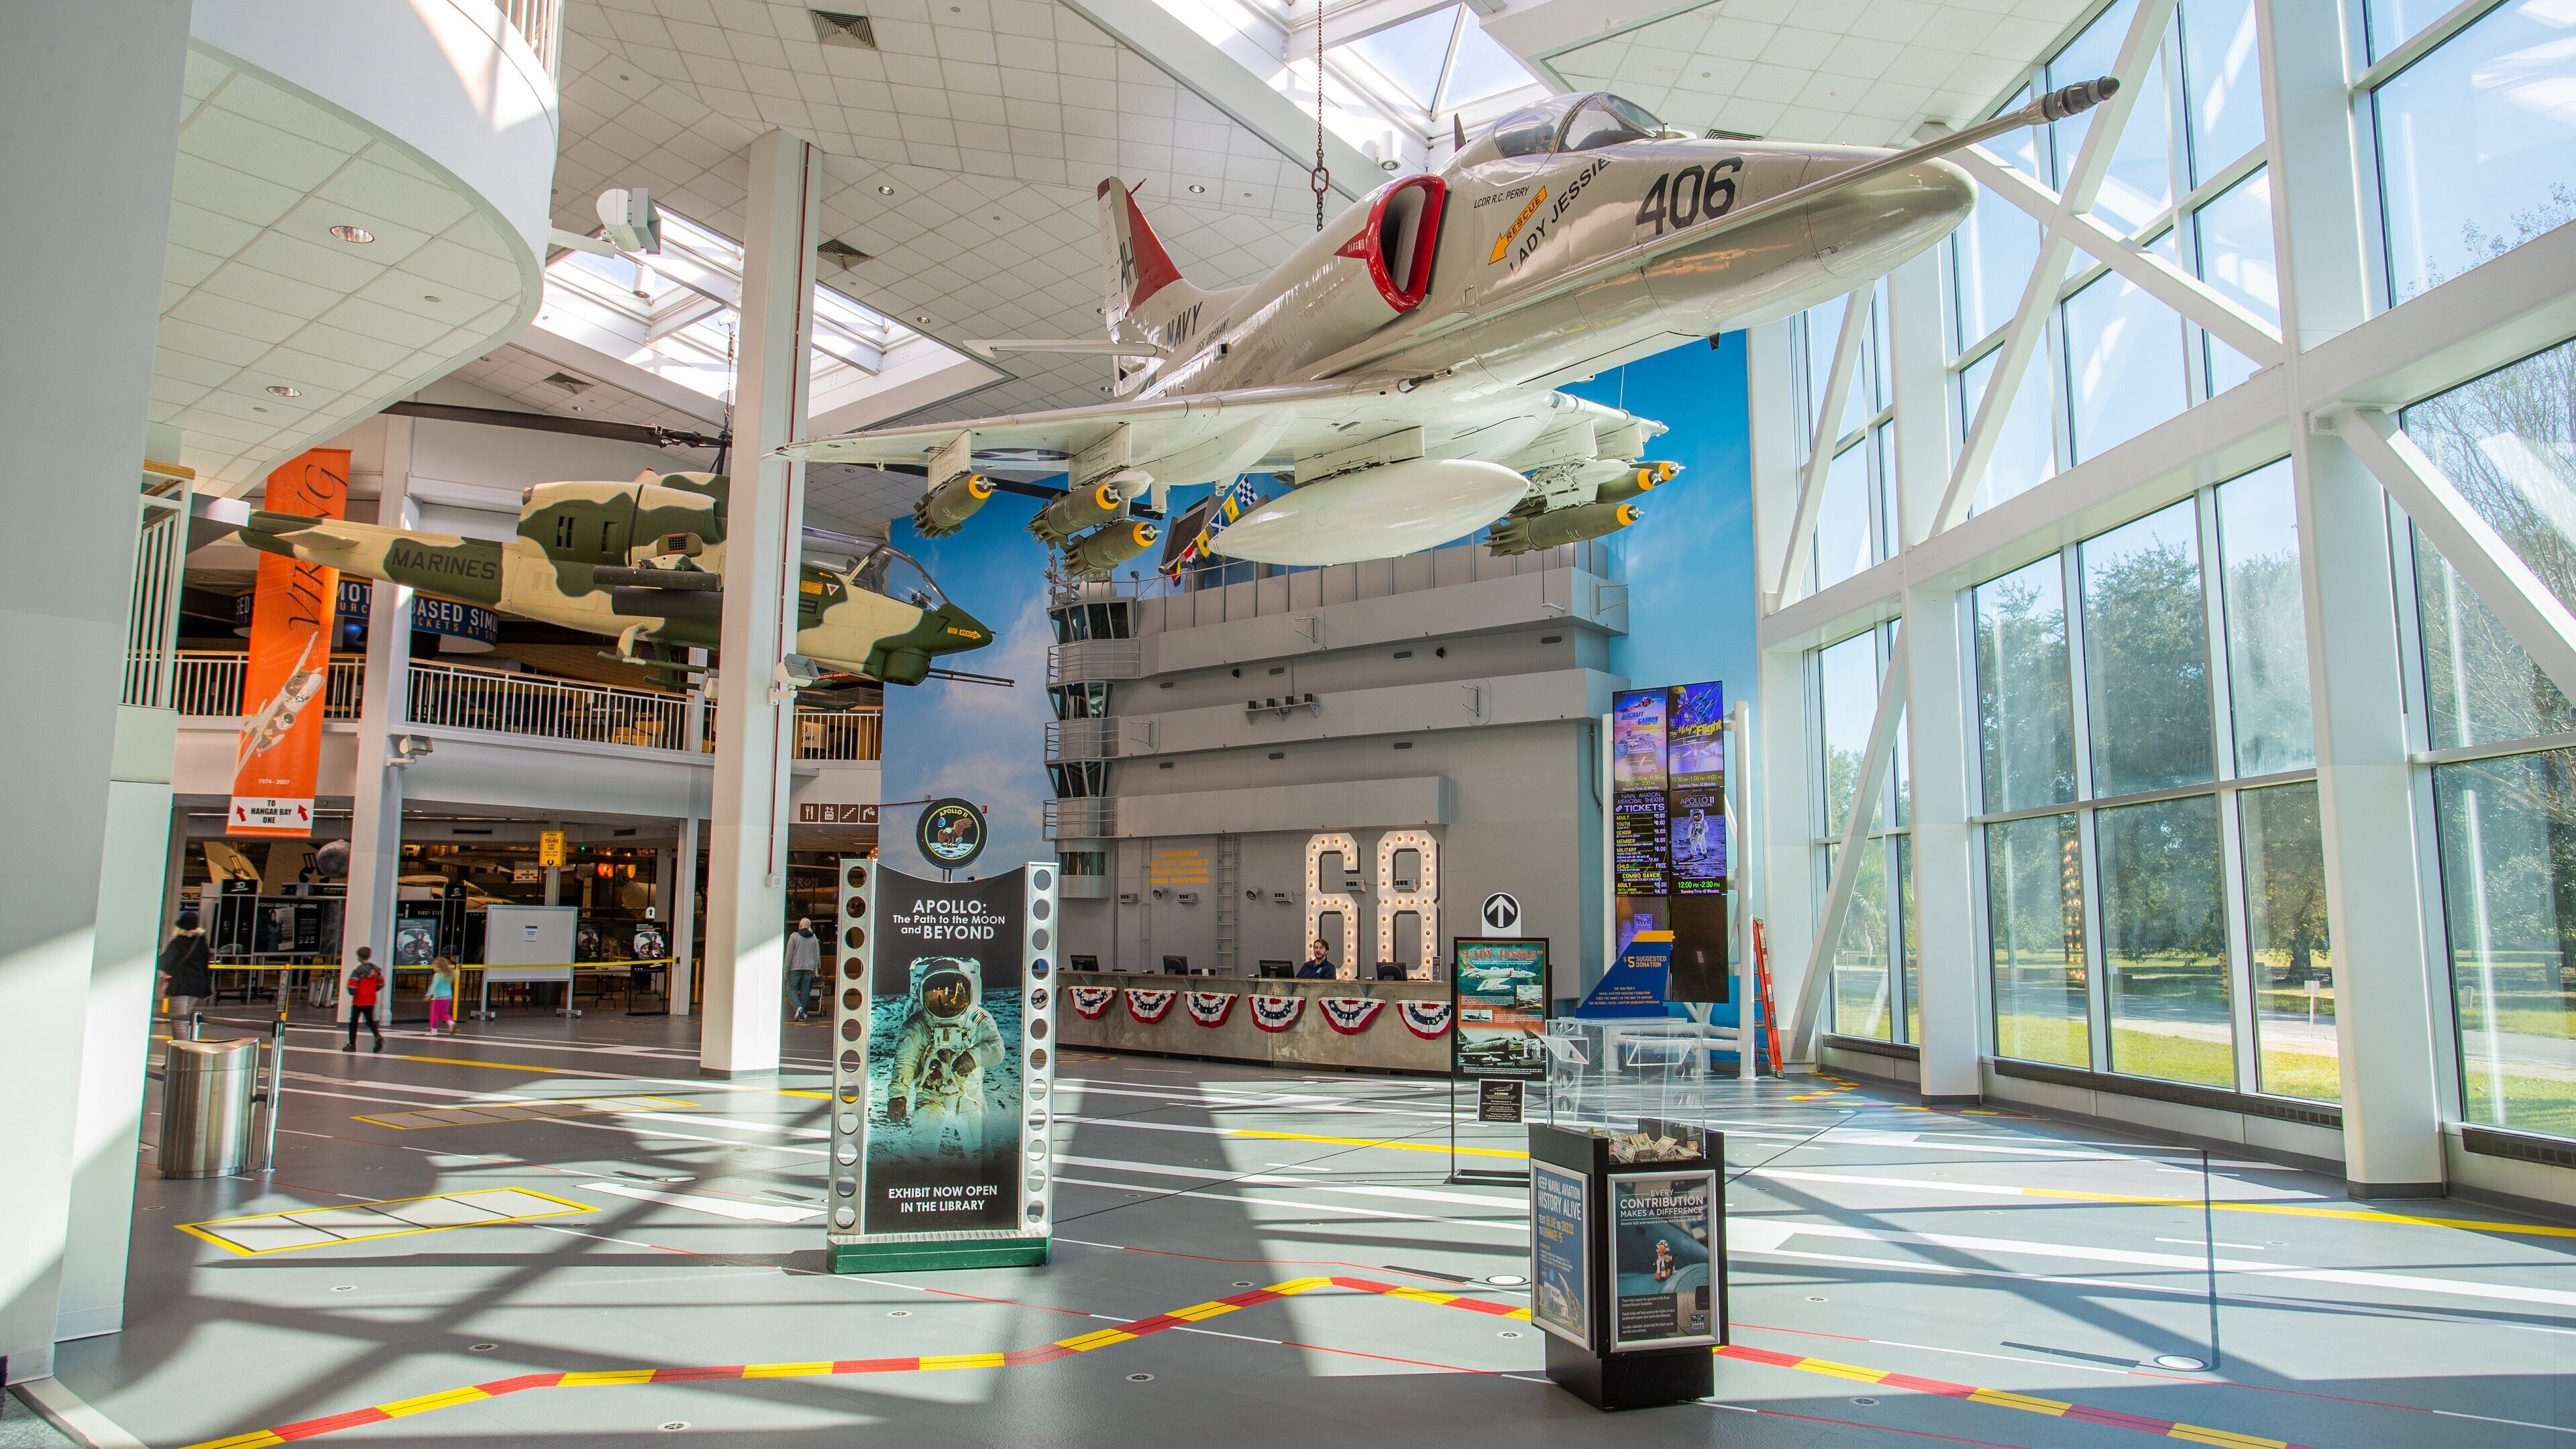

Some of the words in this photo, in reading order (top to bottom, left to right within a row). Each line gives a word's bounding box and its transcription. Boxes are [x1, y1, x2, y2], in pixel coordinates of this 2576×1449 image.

[1474, 196, 1491, 209] LCDR
[1491, 192, 1504, 205] R.C.
[1506, 186, 1529, 201] PERRY
[1635, 156, 1743, 235] 406
[1506, 195, 1541, 242] RESCUE
[1509, 218, 1546, 277] LADY
[1552, 158, 1611, 223] JESSIE
[1167, 301, 1203, 354] NAVY
[392, 547, 497, 580] MARINES
[936, 616, 951, 633] 7
[960, 630, 979, 638] RESCUE
[1621, 712, 1644, 720] AIRCRAFT
[1638, 716, 1658, 725] CARRIER
[1696, 719, 1723, 735] Flight
[1680, 796, 1708, 804] APOLLO
[940, 808, 963, 817] APOLLO
[1624, 804, 1665, 812] TICKETS
[912, 900, 987, 914] APOLLO:
[1305, 830, 1440, 981] 68
[893, 915, 911, 924] The
[914, 915, 936, 924] Path
[939, 915, 949, 924] to
[952, 915, 969, 924] the
[971, 916, 1006, 924] MOON
[901, 926, 922, 934] and
[924, 926, 994, 939] BEYOND
[888, 1187, 931, 1199] EXHIBIT
[933, 1186, 963, 1197] NOW
[966, 1185, 998, 1196] OPEN
[1538, 1175, 1548, 1189] KEEP
[1548, 1179, 1561, 1194] NAVAL
[1562, 1183, 1580, 1201] AVIATION
[901, 1202, 913, 1213] IN
[916, 1201, 936, 1212] THE
[939, 1199, 985, 1212] LIBRARY
[1538, 1190, 1562, 1214] HISTORY
[1563, 1198, 1581, 1221] ALIVE
[1620, 1195, 1703, 1209] CONTRIBUTION
[1621, 1210, 1647, 1218] MAKES
[1656, 1206, 1703, 1216] DIFFERENCE
[1546, 1215, 1556, 1228] BLUE
[1557, 1221, 1561, 1230] TO
[1539, 1226, 1543, 1235] TO
[1543, 1227, 1558, 1241] DONATE
